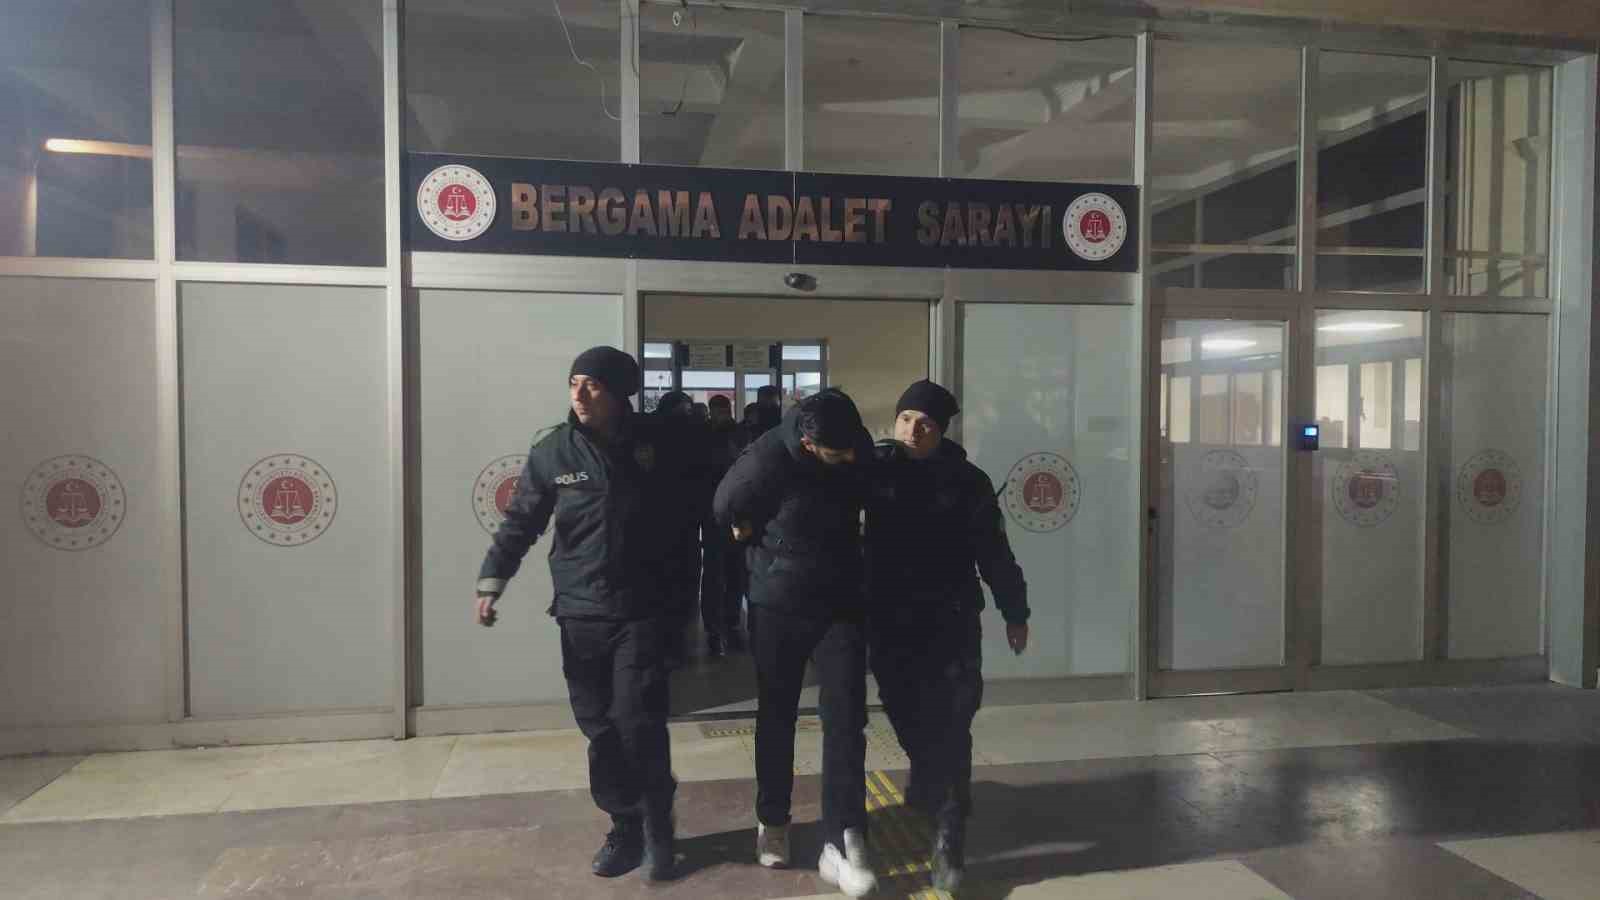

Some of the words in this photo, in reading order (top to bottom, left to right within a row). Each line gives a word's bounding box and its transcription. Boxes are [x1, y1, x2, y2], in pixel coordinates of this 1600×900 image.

[511, 182, 721, 238] BERGAMA
[738, 193, 892, 242] ADALET
[916, 201, 1051, 248] SARAYI
